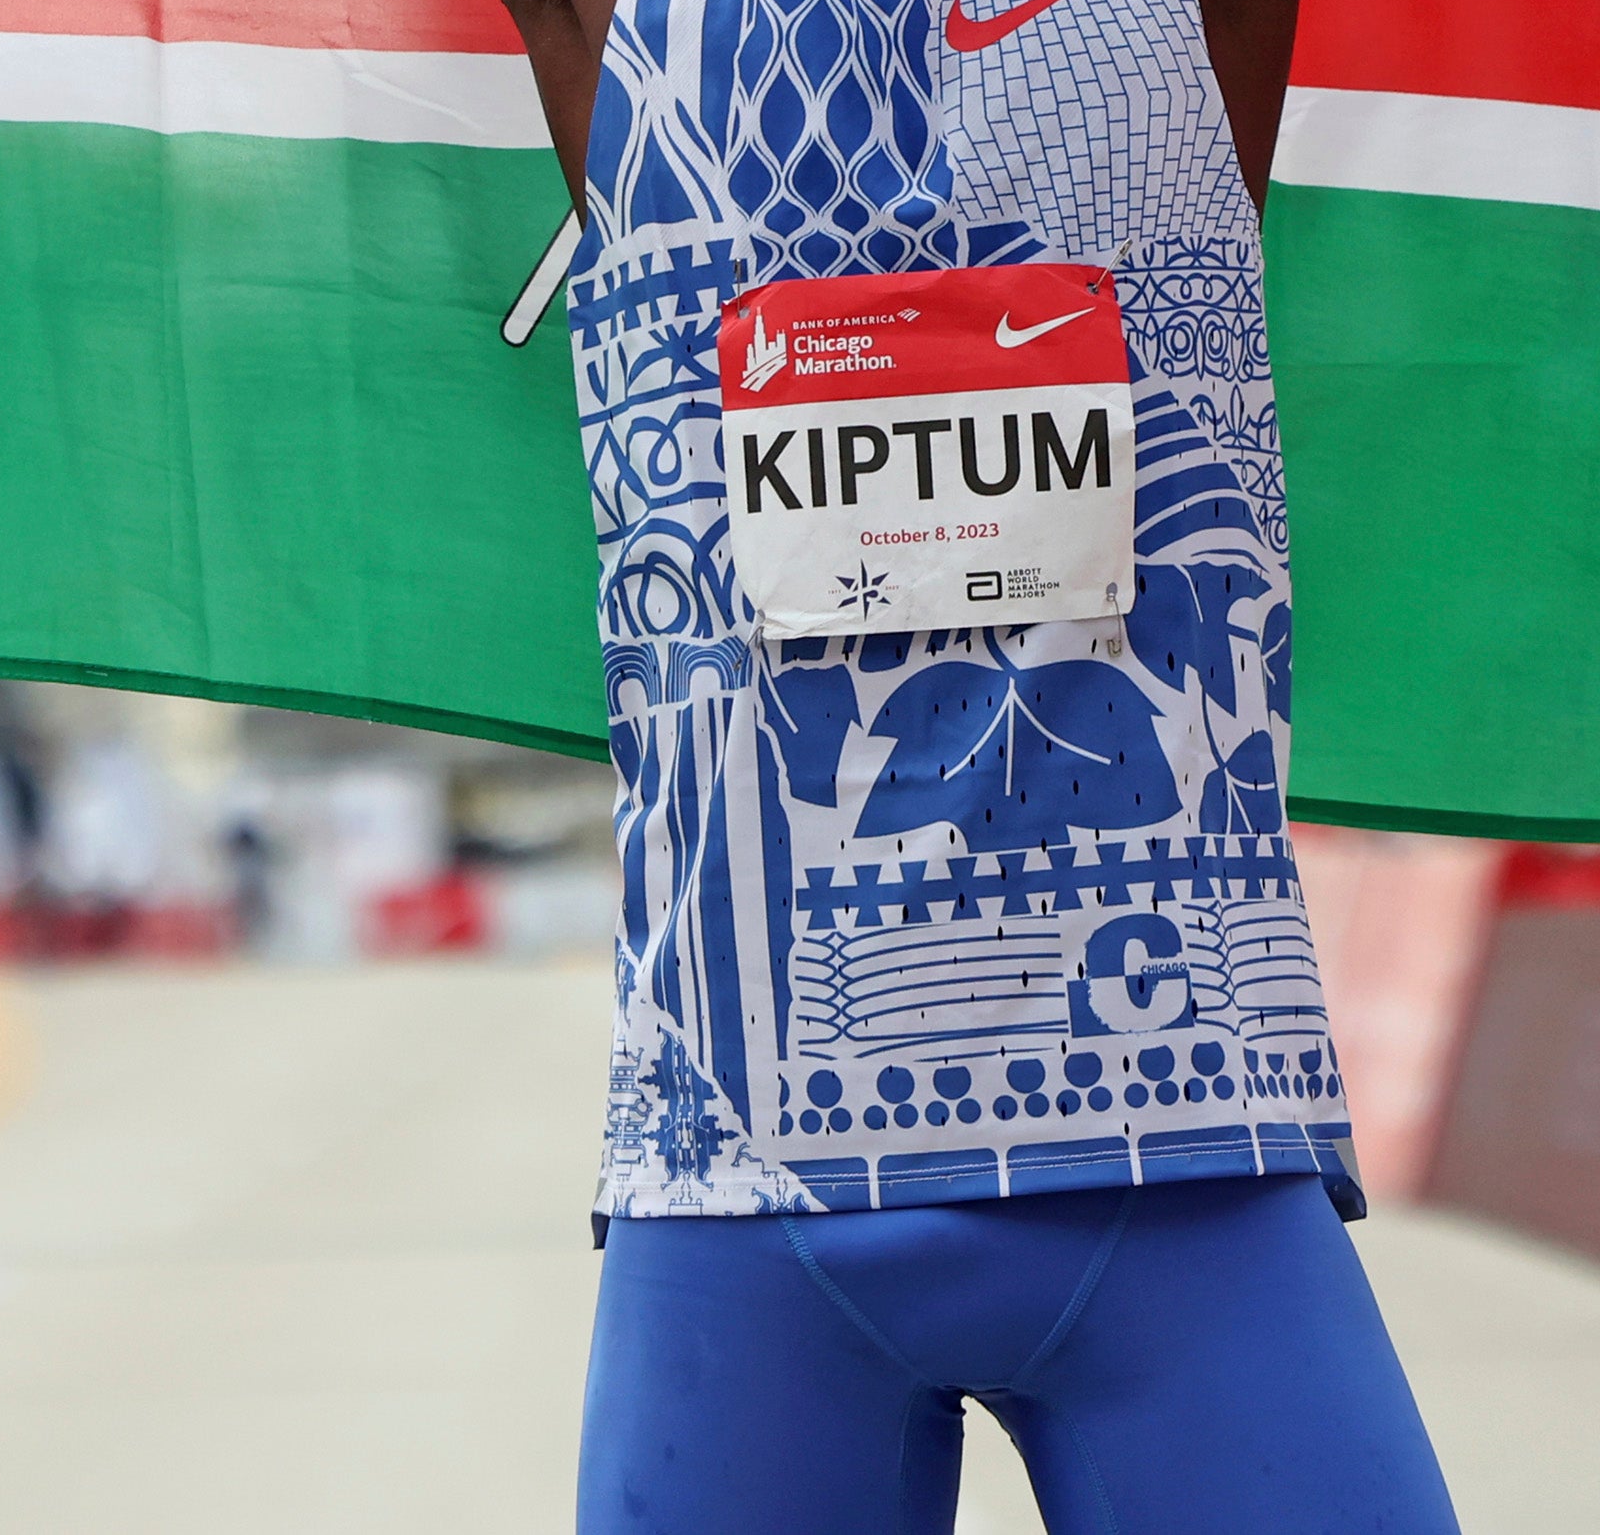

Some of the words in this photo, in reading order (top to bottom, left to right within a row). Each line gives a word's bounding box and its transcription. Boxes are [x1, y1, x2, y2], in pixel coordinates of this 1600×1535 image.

[793, 320, 824, 330] BANK
[826, 318, 840, 327] OF
[843, 314, 895, 326] AMERICA
[794, 334, 873, 354] Chicago
[742, 408, 1112, 514] KIPTUM
[860, 528, 929, 546] October
[935, 526, 950, 542] 8,
[956, 522, 1000, 540] 2023
[1007, 568, 1041, 577] ABBOTT
[1007, 575, 1039, 584] WORLD
[1008, 582, 1060, 591] MARATHON
[1008, 590, 1045, 599] MAJORS
[1140, 962, 1187, 974] CHICAGO
